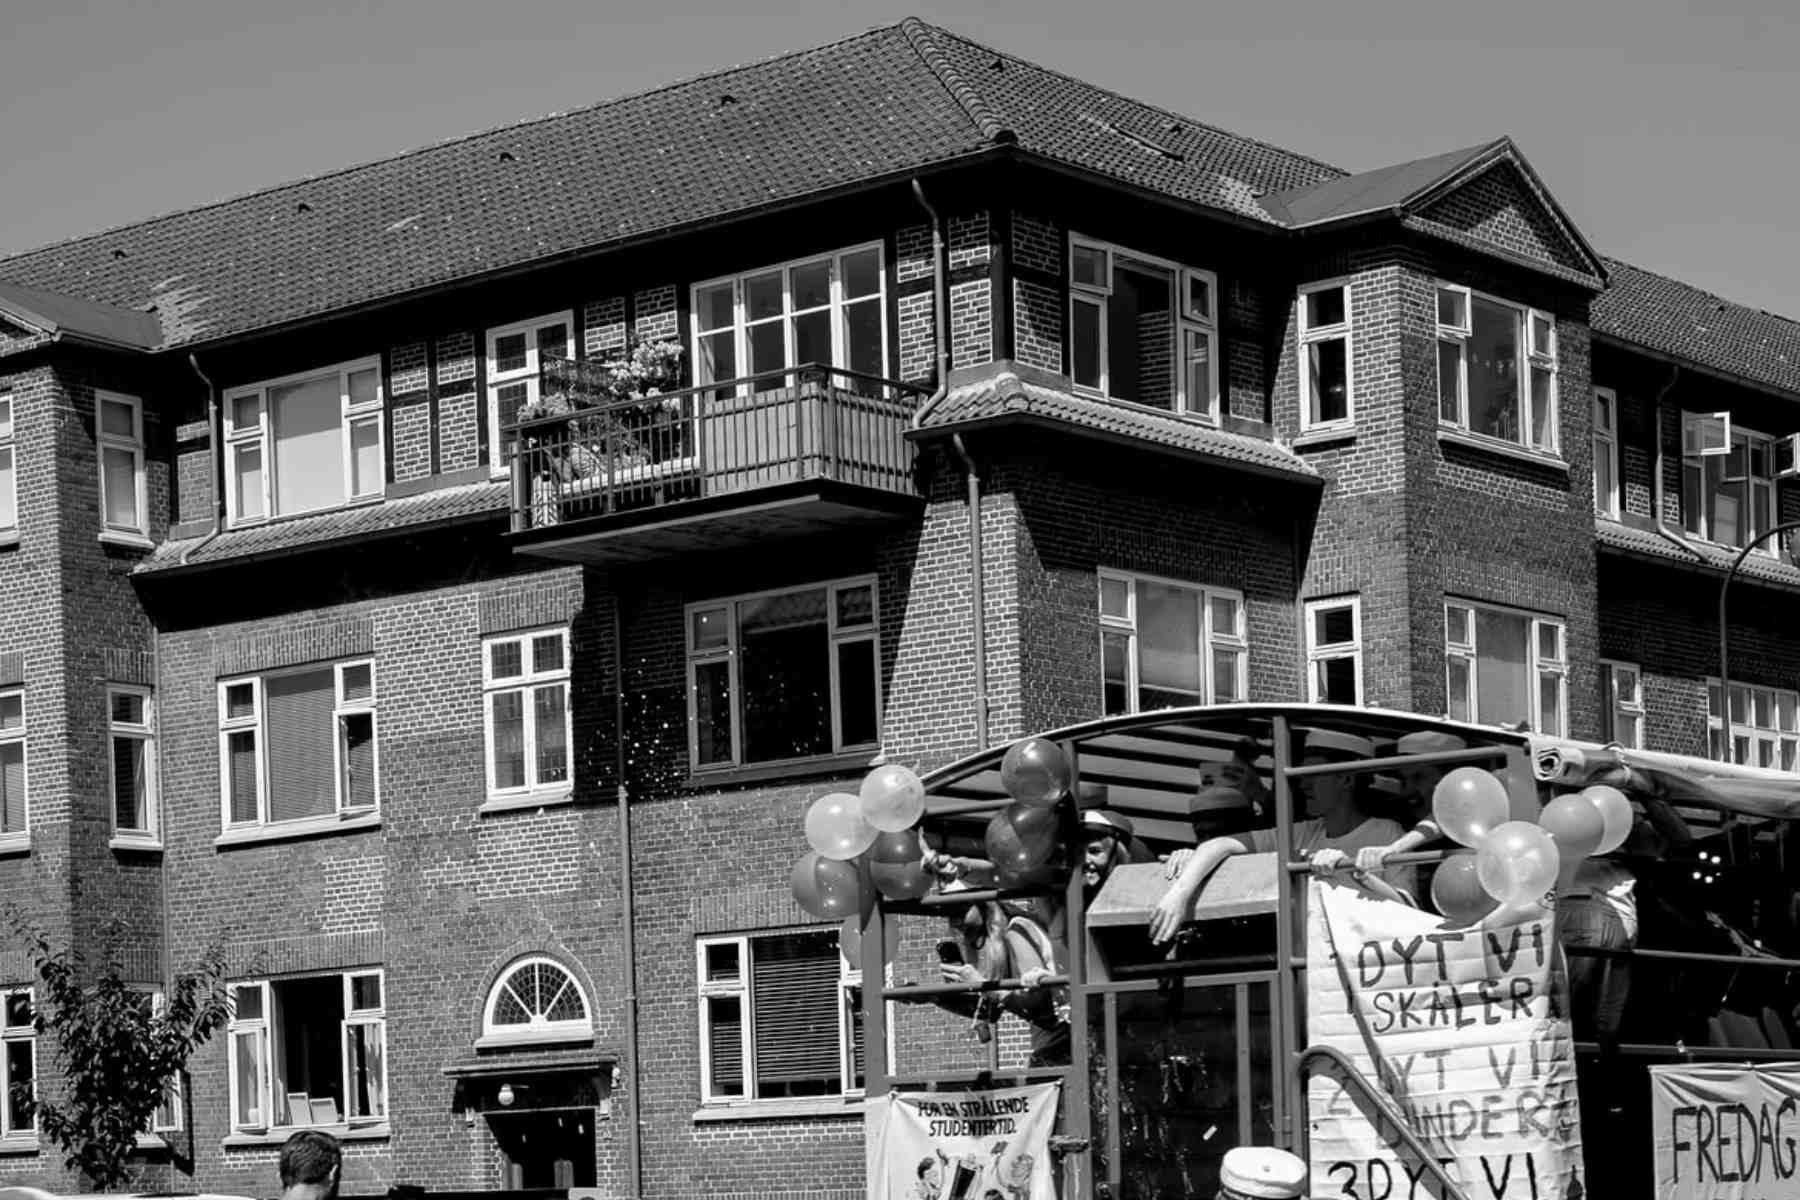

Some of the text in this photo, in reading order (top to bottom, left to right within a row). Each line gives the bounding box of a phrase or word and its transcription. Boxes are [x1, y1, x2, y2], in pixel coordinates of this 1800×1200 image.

[1358, 932, 1464, 988] DYT
[1487, 922, 1544, 974] VI
[1488, 1039, 1539, 1089] VI
[1672, 1097, 1797, 1184] FREDAG
